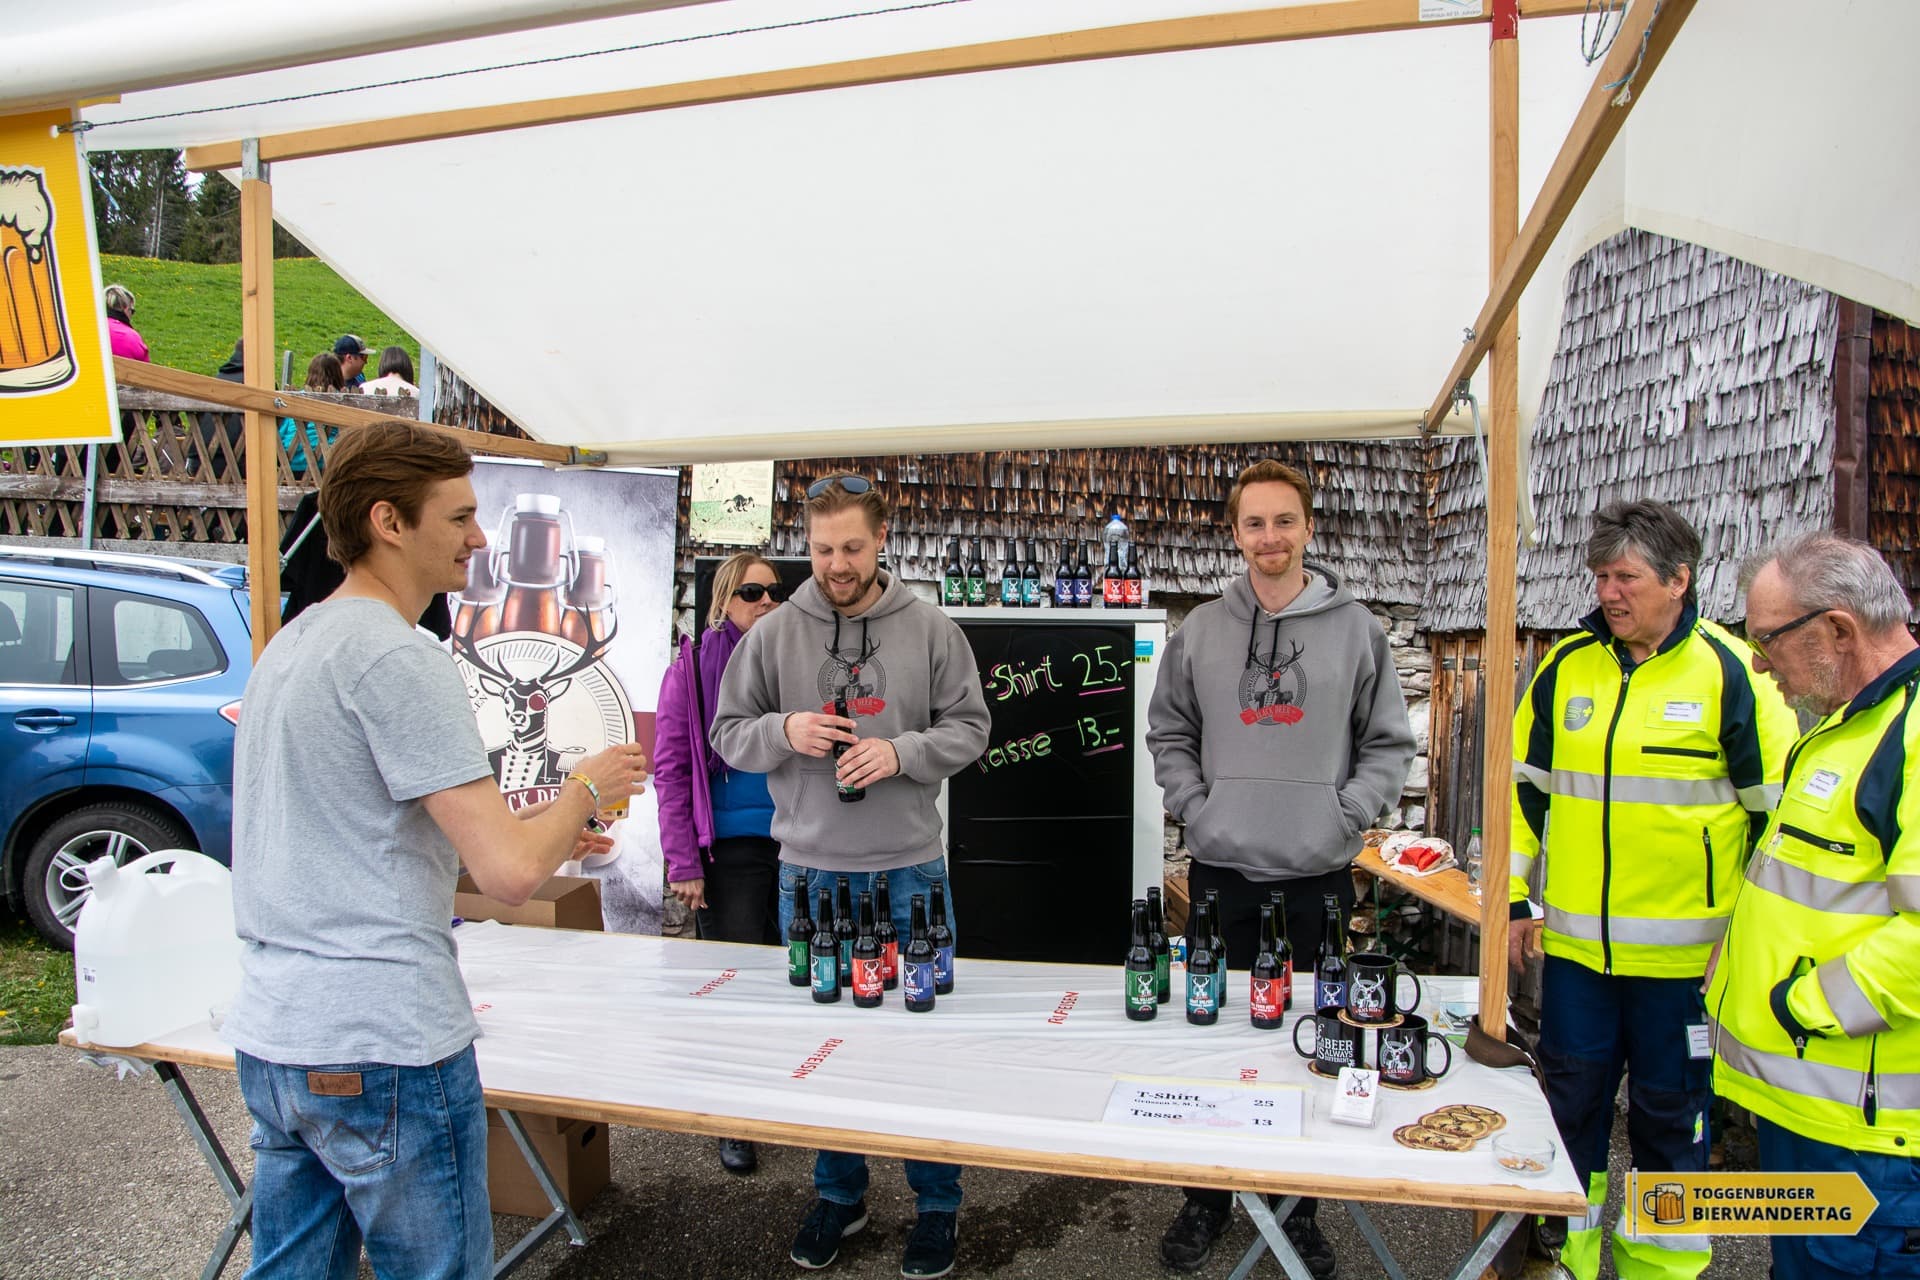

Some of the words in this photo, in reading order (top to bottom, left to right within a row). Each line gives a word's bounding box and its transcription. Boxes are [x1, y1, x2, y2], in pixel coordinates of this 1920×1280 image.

[984, 655, 1063, 701] -Shirt
[1325, 1038, 1353, 1051] BEER
[1325, 1049, 1354, 1058] ALWAYS
[1136, 1090, 1200, 1102] T-Shirt
[1254, 1099, 1274, 1107] 25
[1130, 1108, 1183, 1120] Tasse
[1252, 1118, 1273, 1126] 13
